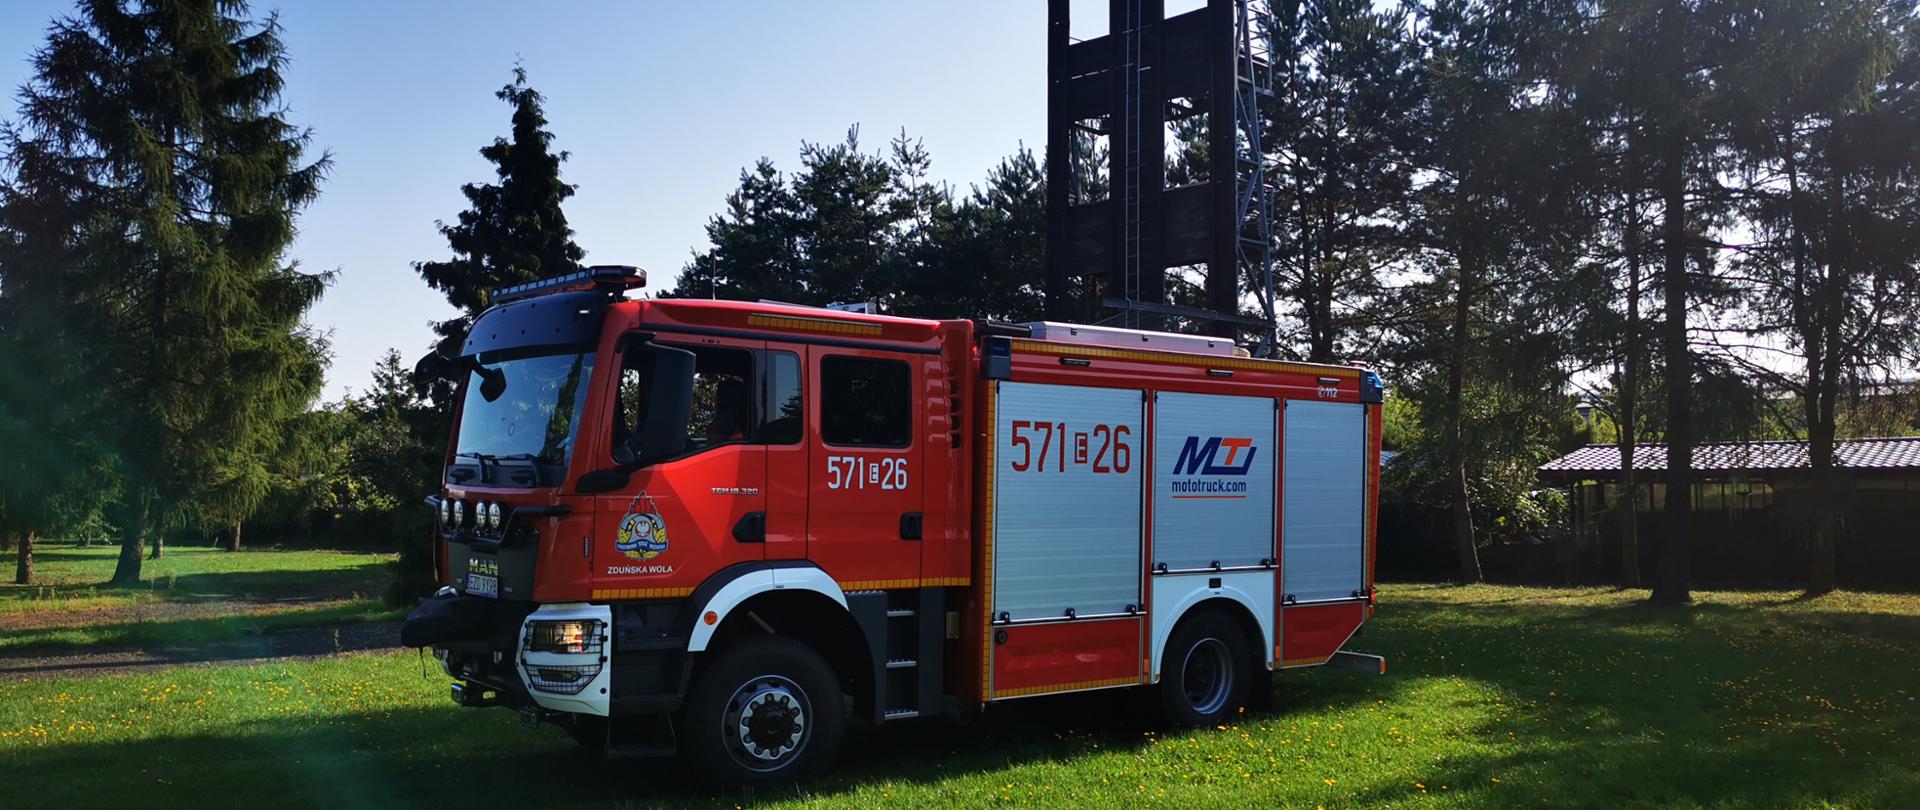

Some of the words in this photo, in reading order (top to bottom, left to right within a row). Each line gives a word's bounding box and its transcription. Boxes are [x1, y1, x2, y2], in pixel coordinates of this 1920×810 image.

[1326, 387, 1337, 398] 112
[1011, 420, 1065, 472] 571
[1093, 424, 1131, 473] 26
[827, 456, 864, 489] 571
[881, 458, 908, 490] 26
[1171, 479, 1247, 493] mototruck.com
[469, 558, 499, 576] MAN
[607, 565, 648, 574] ZDUŃSKA
[649, 565, 673, 573] WOLA
